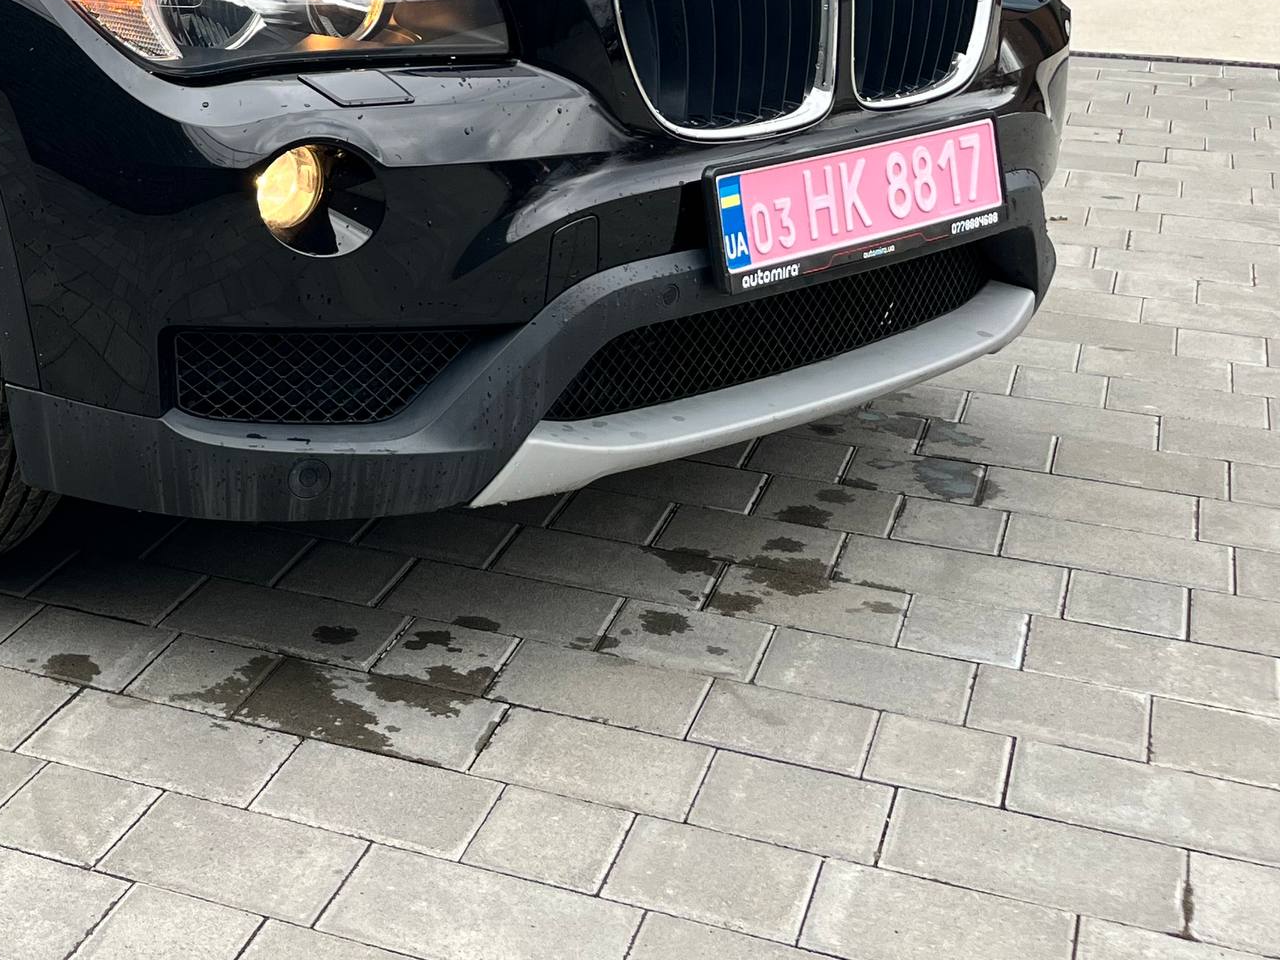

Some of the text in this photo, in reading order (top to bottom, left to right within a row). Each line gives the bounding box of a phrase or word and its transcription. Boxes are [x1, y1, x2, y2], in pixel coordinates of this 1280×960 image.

[750, 132, 981, 255] 03 HK 8817
[724, 231, 749, 260] UA
[741, 263, 799, 289] automira
